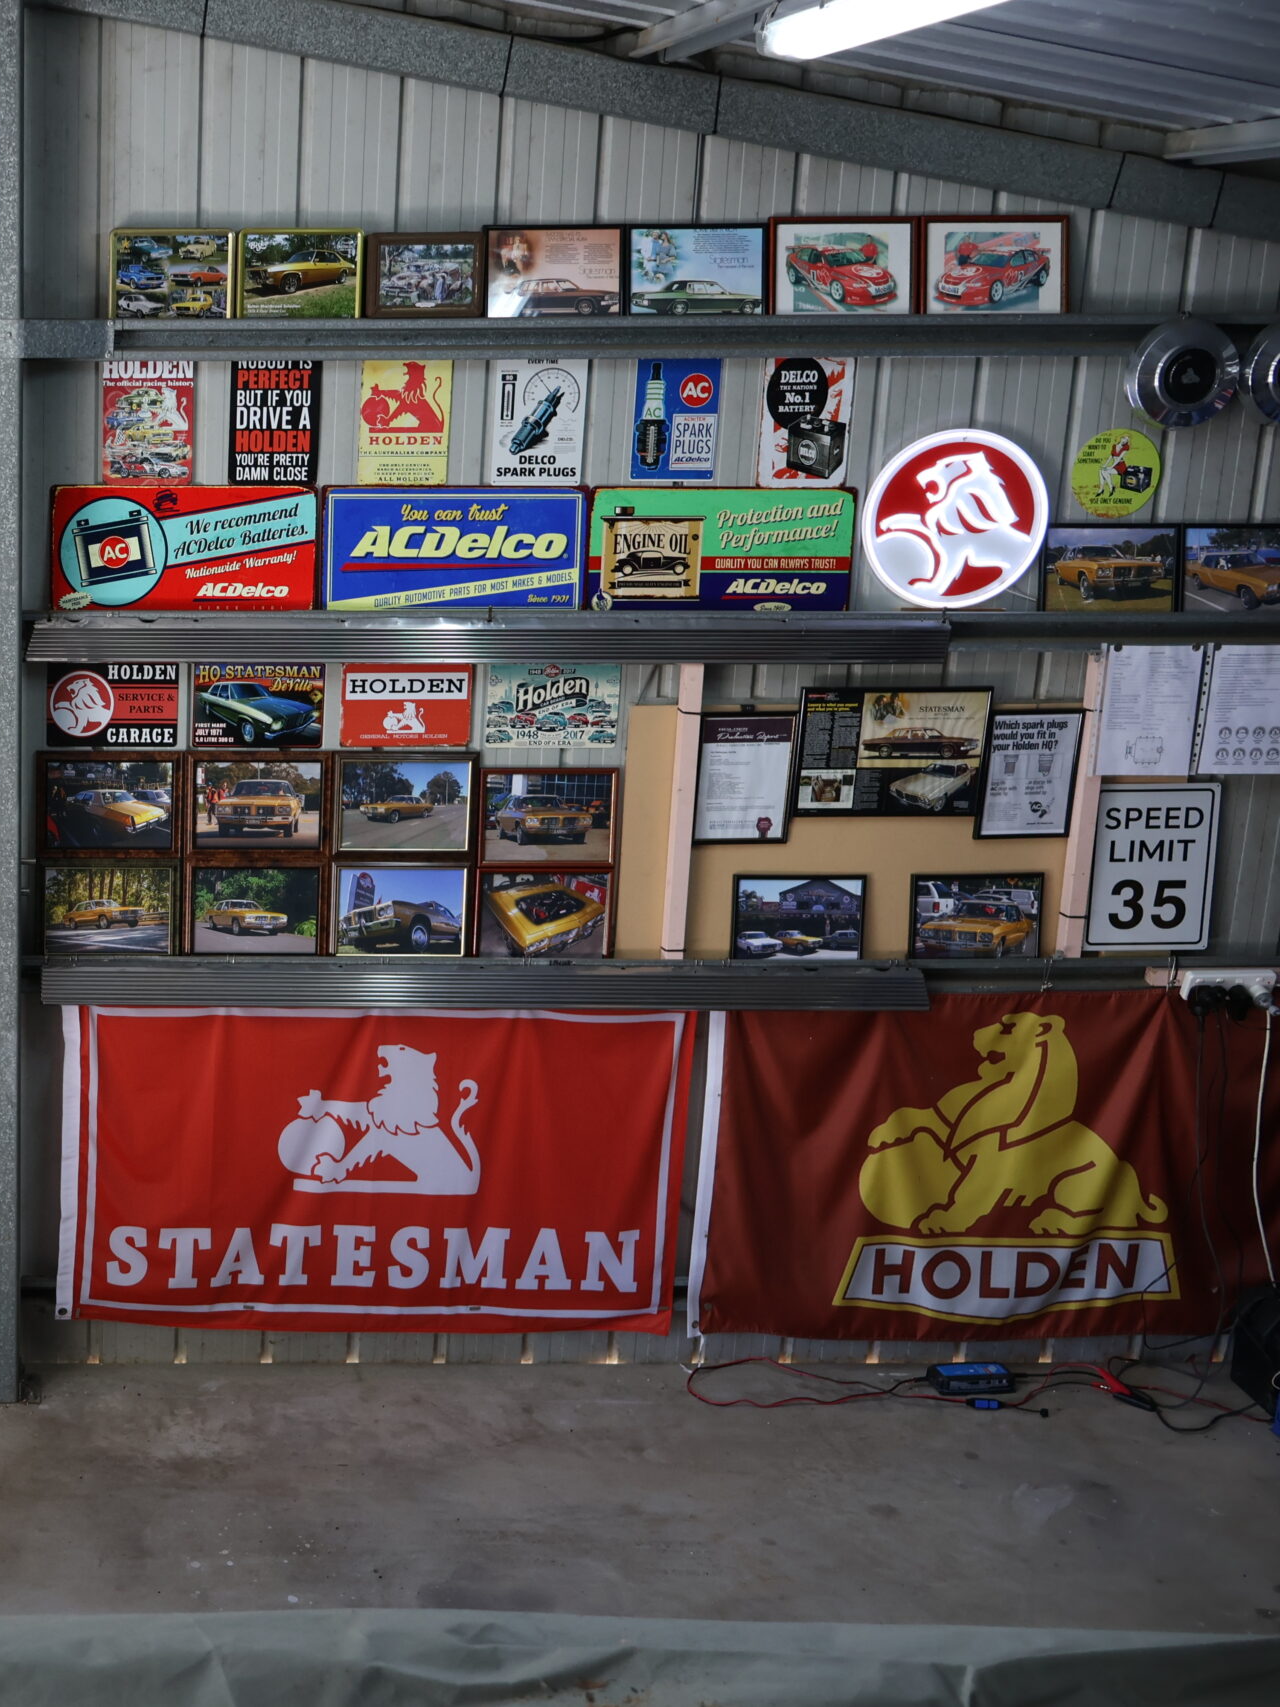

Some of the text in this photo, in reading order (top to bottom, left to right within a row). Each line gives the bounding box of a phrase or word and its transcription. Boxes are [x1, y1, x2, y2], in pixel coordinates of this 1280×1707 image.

[238, 370, 312, 389] PERFECT
[780, 371, 818, 383] DELCO
[682, 382, 709, 398] AC
[236, 390, 311, 407] BUT IF YOU
[645, 408, 662, 417] AC
[778, 405, 815, 413] BATTERY
[236, 407, 311, 429] DRIVE A
[676, 423, 712, 438] SPARK
[235, 430, 310, 452] HOLDEN
[369, 436, 443, 446] HOLDEN
[674, 439, 711, 454] PLUGS
[235, 454, 310, 465] YOU'RE PRETTY
[519, 455, 556, 465] DELCO
[236, 467, 308, 481] DAMN CLOSE
[496, 467, 576, 477] SPARK PLUGS
[214, 503, 299, 531] recommend
[400, 503, 509, 521] You can trust
[716, 498, 845, 528] Protection and
[174, 524, 308, 560] ACDelco Batteries.
[350, 526, 568, 559] ACDelco
[613, 533, 691, 555] ENGINE OIL
[720, 520, 839, 552] Performance!
[103, 544, 127, 561] AC
[185, 562, 241, 579] Nationwide
[715, 558, 836, 569] QUALITY YOU ALWAYS TRUST!
[196, 583, 289, 597] ACDelco
[726, 578, 827, 594] ACDelco
[405, 590, 446, 603] AUTOMOTIVE
[108, 664, 176, 680] HOLDEN
[226, 665, 321, 679] STATESMAN
[349, 678, 466, 694] HOLDEN
[517, 676, 588, 711] Holden
[118, 693, 164, 702] SERVICE
[129, 705, 164, 714] PARTS
[106, 728, 173, 743] GARAGE
[516, 730, 585, 740] 1948 2017
[993, 731, 1018, 740] would
[1012, 741, 1039, 750] Holden
[1104, 807, 1204, 829] SPEED
[1109, 839, 1196, 862] LIMIT
[1108, 879, 1186, 930] 35
[106, 1223, 640, 1293] STATESMAN
[871, 1242, 1140, 1299] HOLDEN
